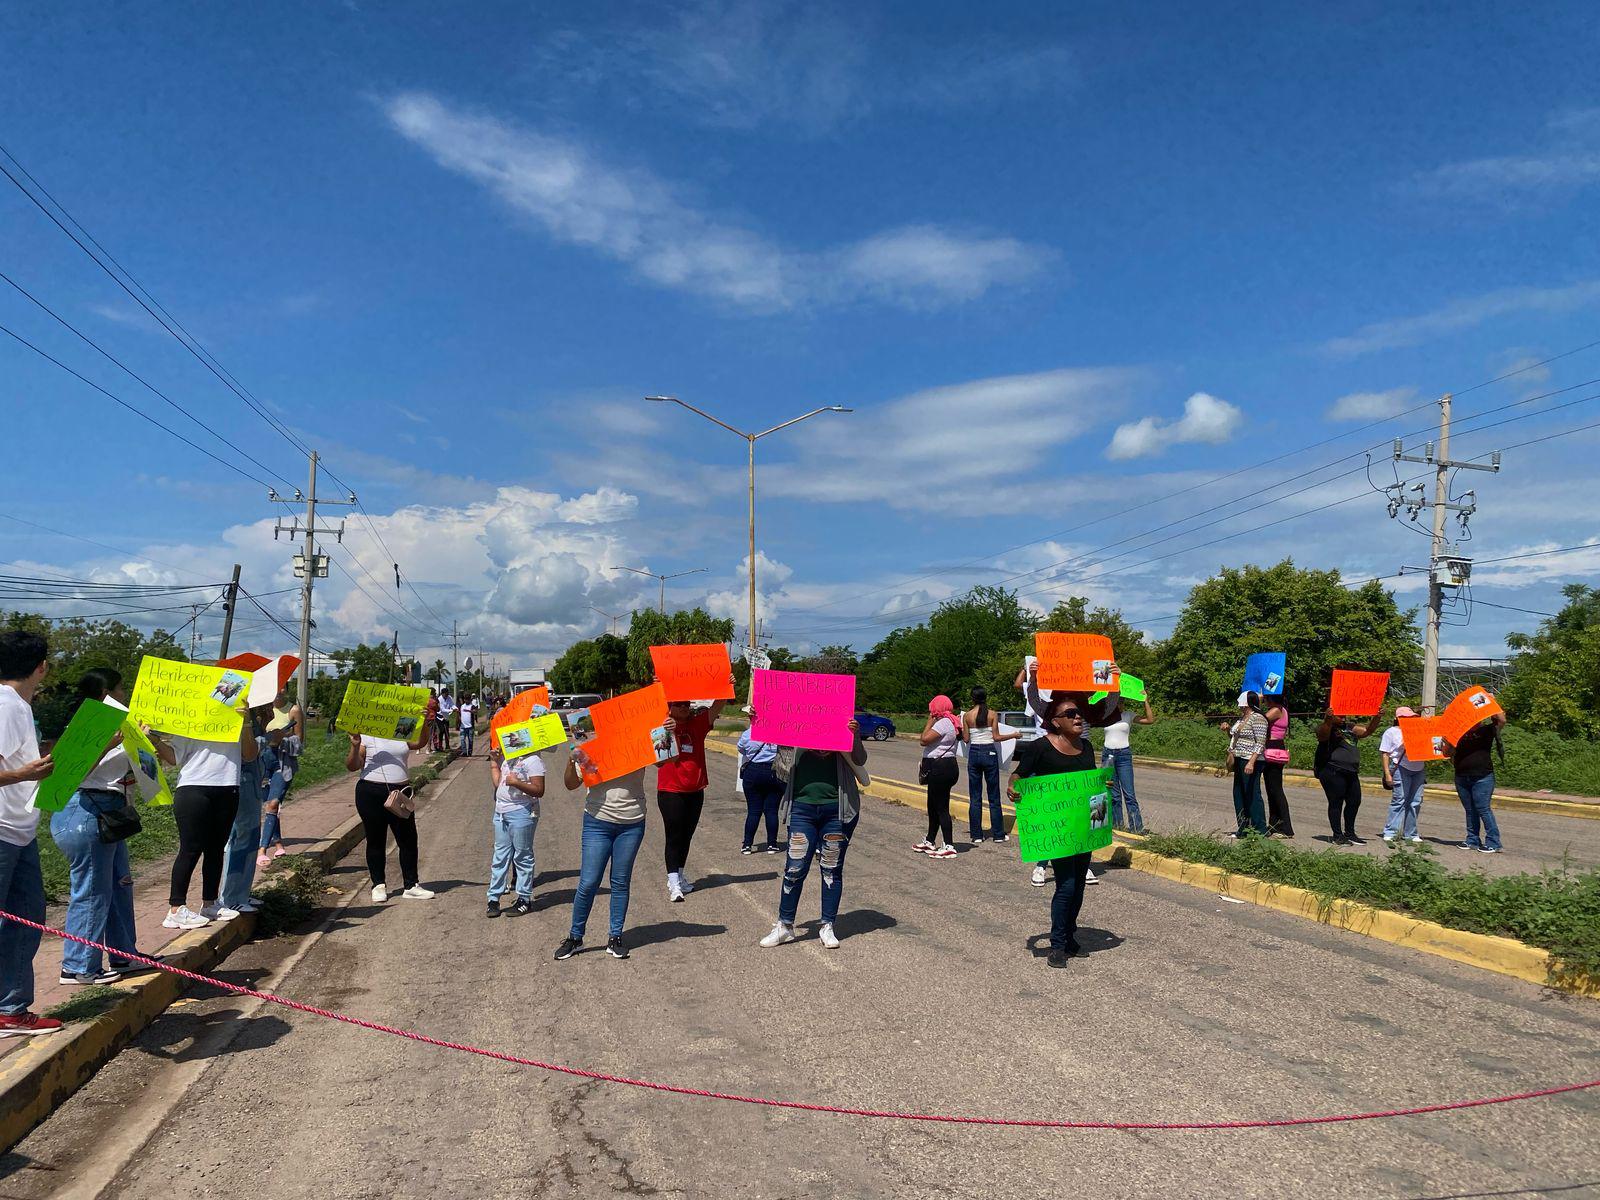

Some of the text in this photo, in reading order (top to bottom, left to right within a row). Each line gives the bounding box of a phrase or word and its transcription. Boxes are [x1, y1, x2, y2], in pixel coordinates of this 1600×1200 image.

[149, 661, 212, 685] Heriberto
[764, 674, 849, 695] HERIBERTO
[154, 697, 197, 718] familia
